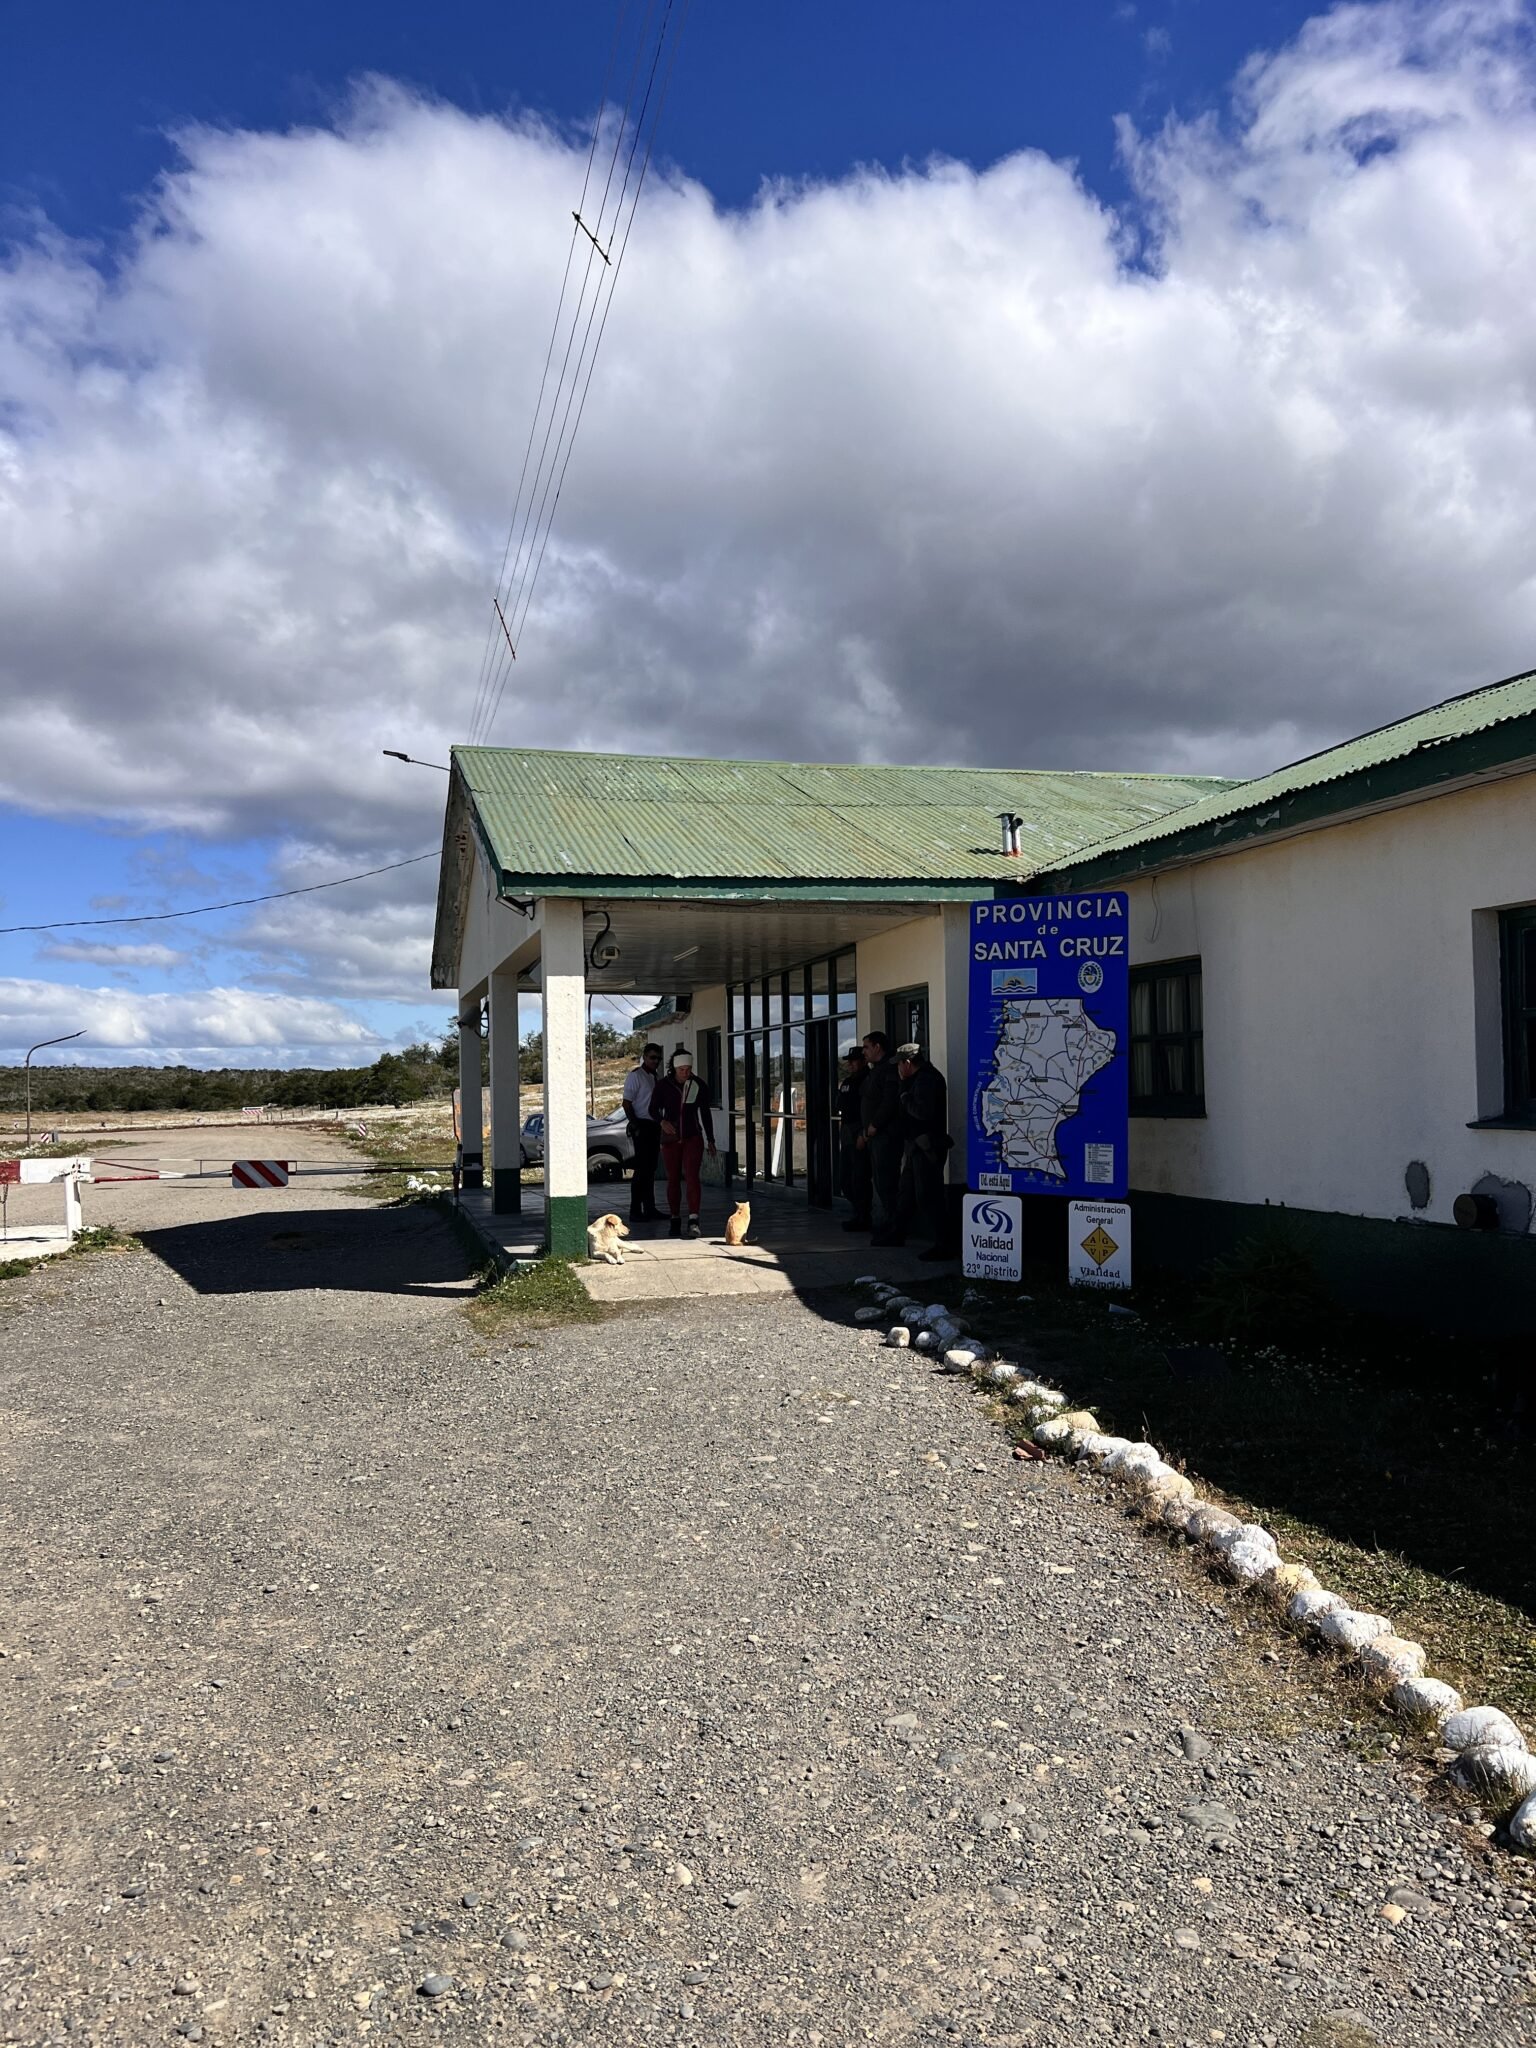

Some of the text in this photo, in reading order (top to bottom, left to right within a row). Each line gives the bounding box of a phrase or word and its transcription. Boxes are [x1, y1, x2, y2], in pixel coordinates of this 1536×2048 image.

[976, 897, 1123, 924] PROVINCIA
[1037, 924, 1059, 935] de
[974, 936, 1124, 961] SANTA CRUZ
[980, 1174, 988, 1186] Ud.
[1086, 1215, 1114, 1225] General
[970, 1234, 1014, 1251] Vialidad
[1089, 1236, 1096, 1244] A
[976, 1251, 1009, 1263] Nacional
[1102, 1249, 1109, 1257] P
[984, 1264, 1019, 1278] Distrito
[1080, 1266, 1121, 1278] Vialidad
